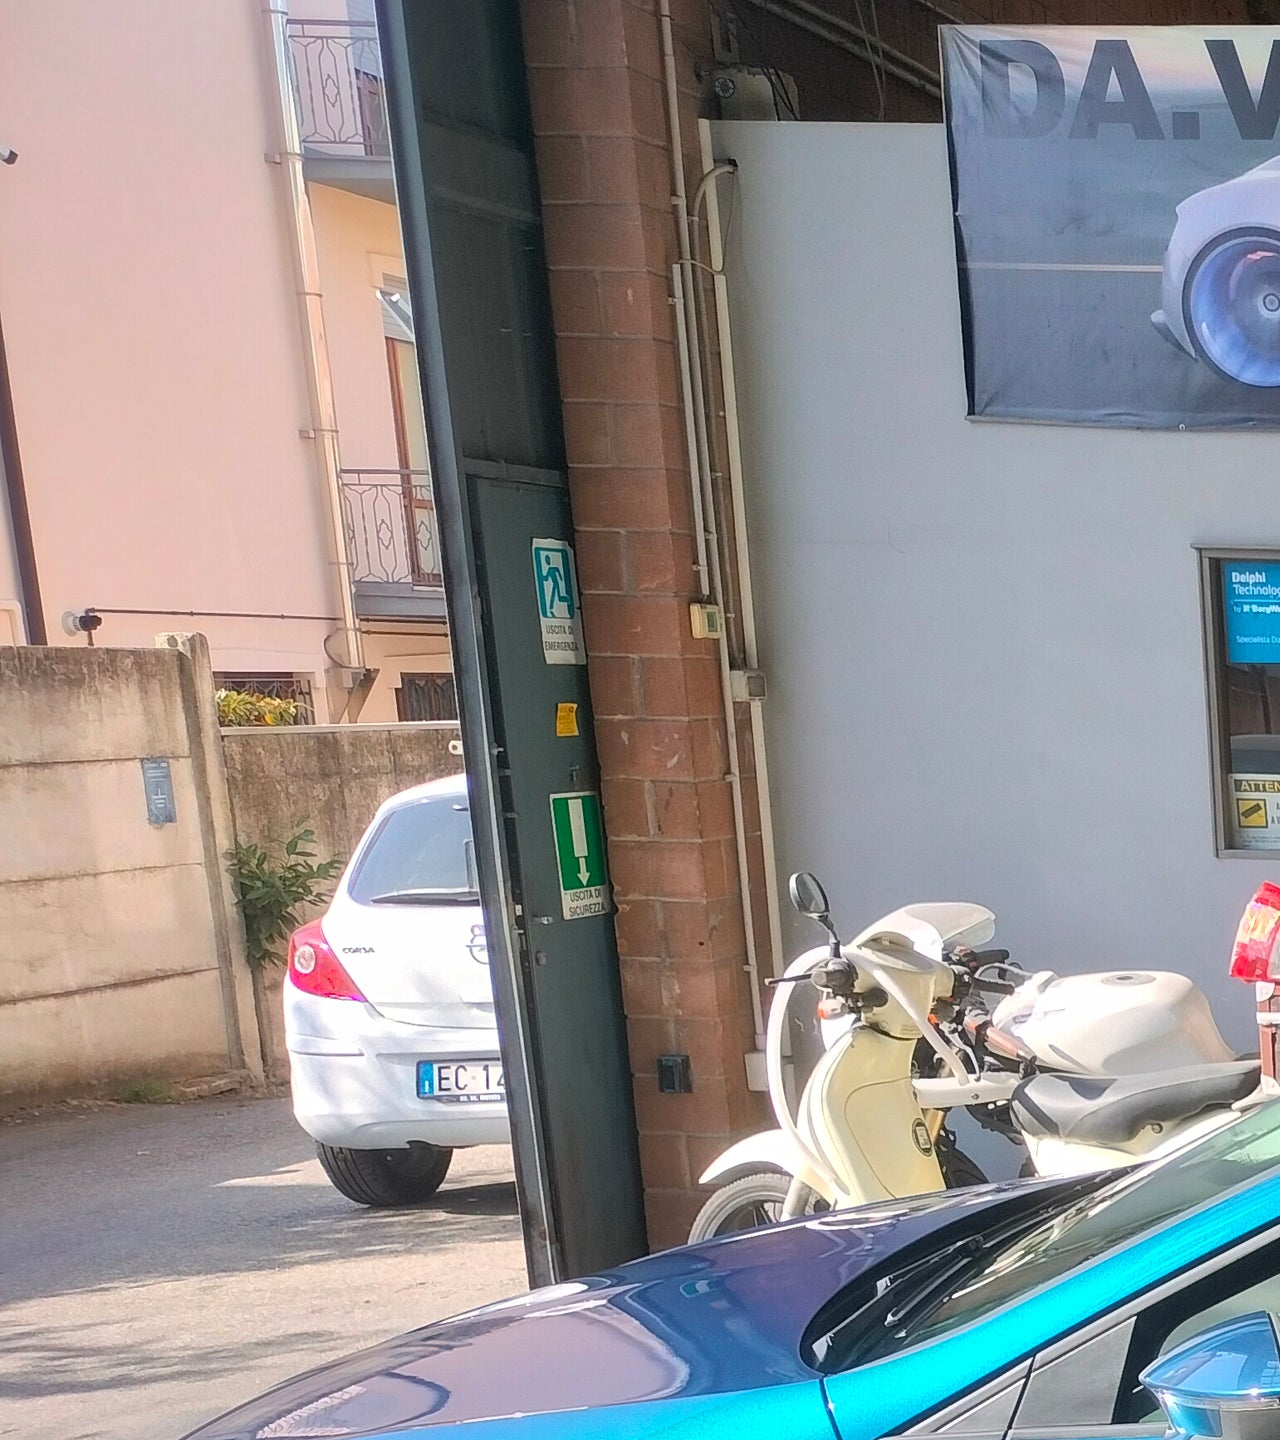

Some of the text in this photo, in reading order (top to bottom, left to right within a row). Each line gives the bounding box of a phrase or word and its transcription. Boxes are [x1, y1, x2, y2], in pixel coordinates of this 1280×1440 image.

[1231, 571, 1266, 584] Delphi
[545, 624, 567, 635] USCITA
[1271, 816, 1276, 825] A
[570, 889, 594, 902] USCITA
[569, 902, 607, 917] SICUREZZA
[437, 1065, 467, 1091] EC
